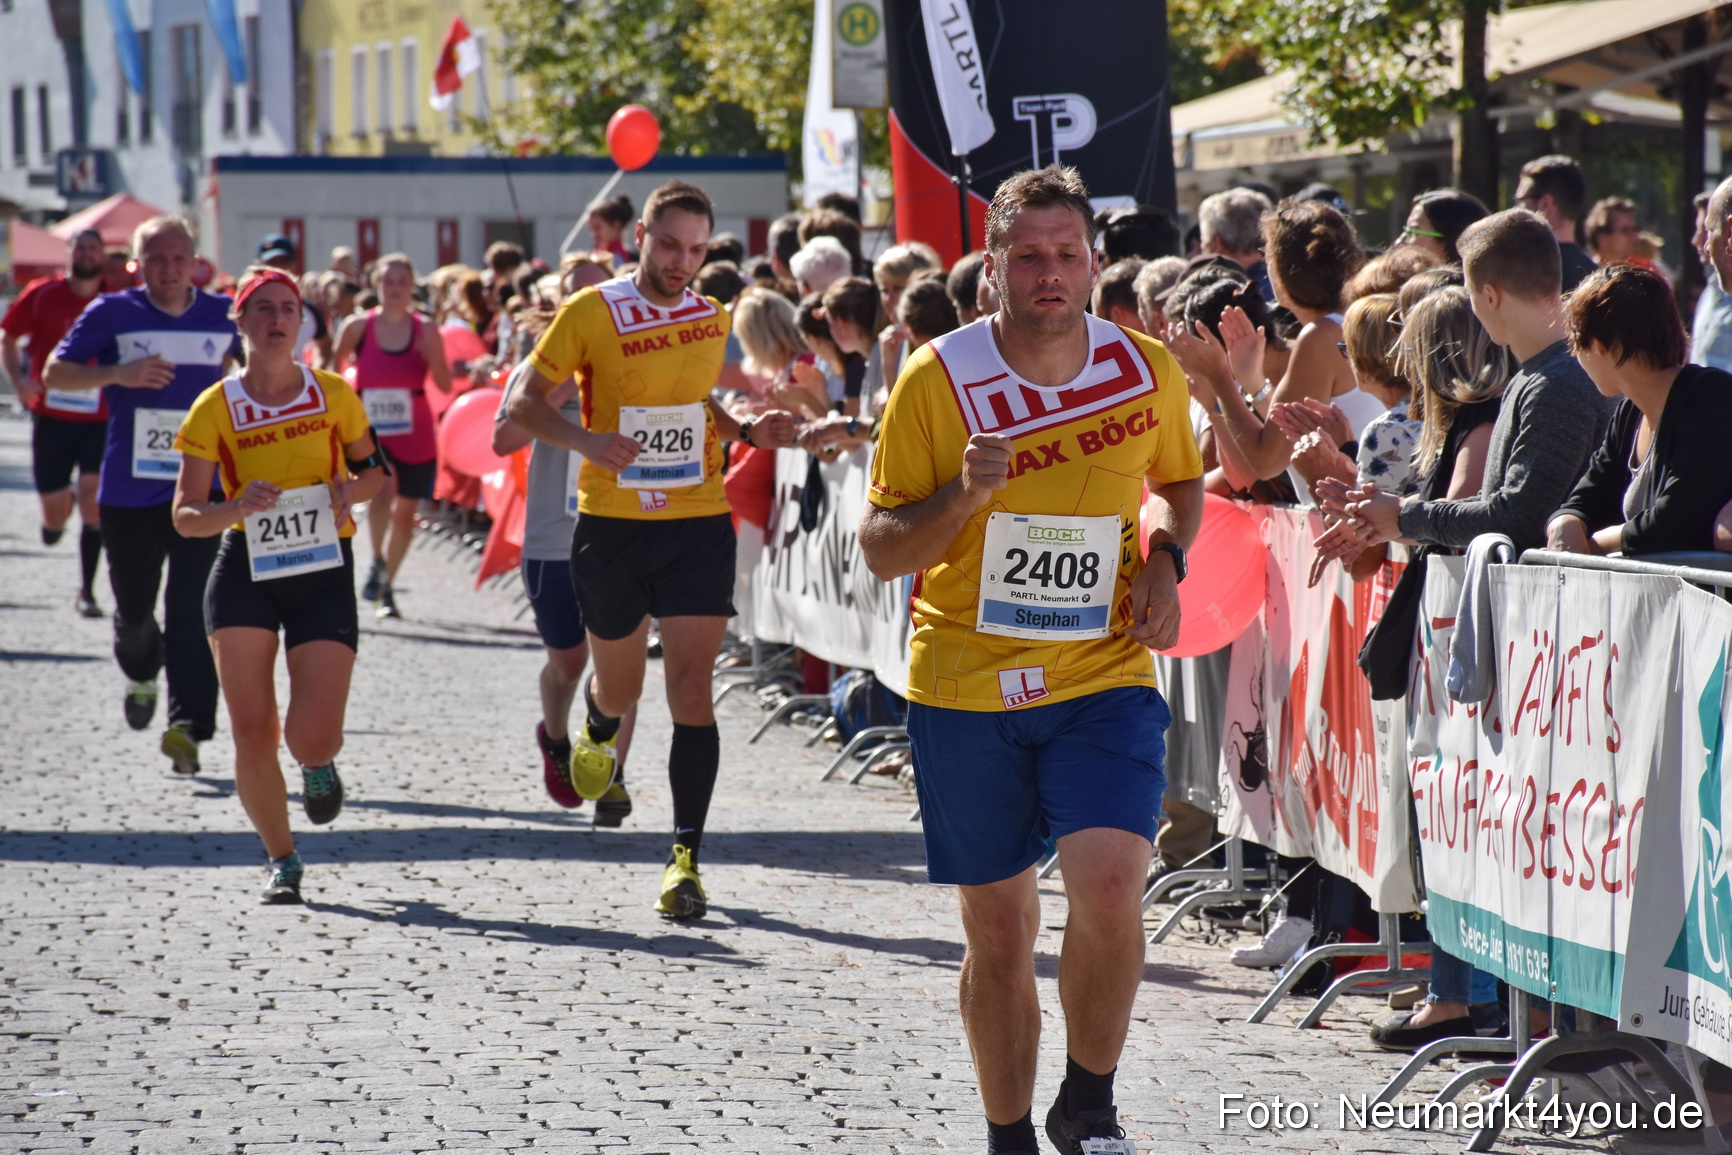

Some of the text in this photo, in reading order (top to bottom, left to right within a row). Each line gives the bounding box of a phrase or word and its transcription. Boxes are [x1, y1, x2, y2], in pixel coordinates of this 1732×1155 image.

[940, 3, 983, 111] ARTL
[621, 322, 724, 357] MAX BÖGL
[146, 429, 178, 450] 23
[236, 419, 330, 450] MAX BÖGL
[633, 427, 693, 454] 2426
[1076, 407, 1160, 457] BÖGL
[640, 467, 685, 480] Matthias
[258, 509, 319, 543] 2417
[1028, 526, 1085, 541] BOCK
[276, 551, 314, 567] Marina
[1003, 548, 1100, 589] 2408
[1010, 591, 1079, 602] PARTL Neumarkt
[1015, 608, 1080, 629] Stephan
[1659, 985, 1690, 1021] Jura
